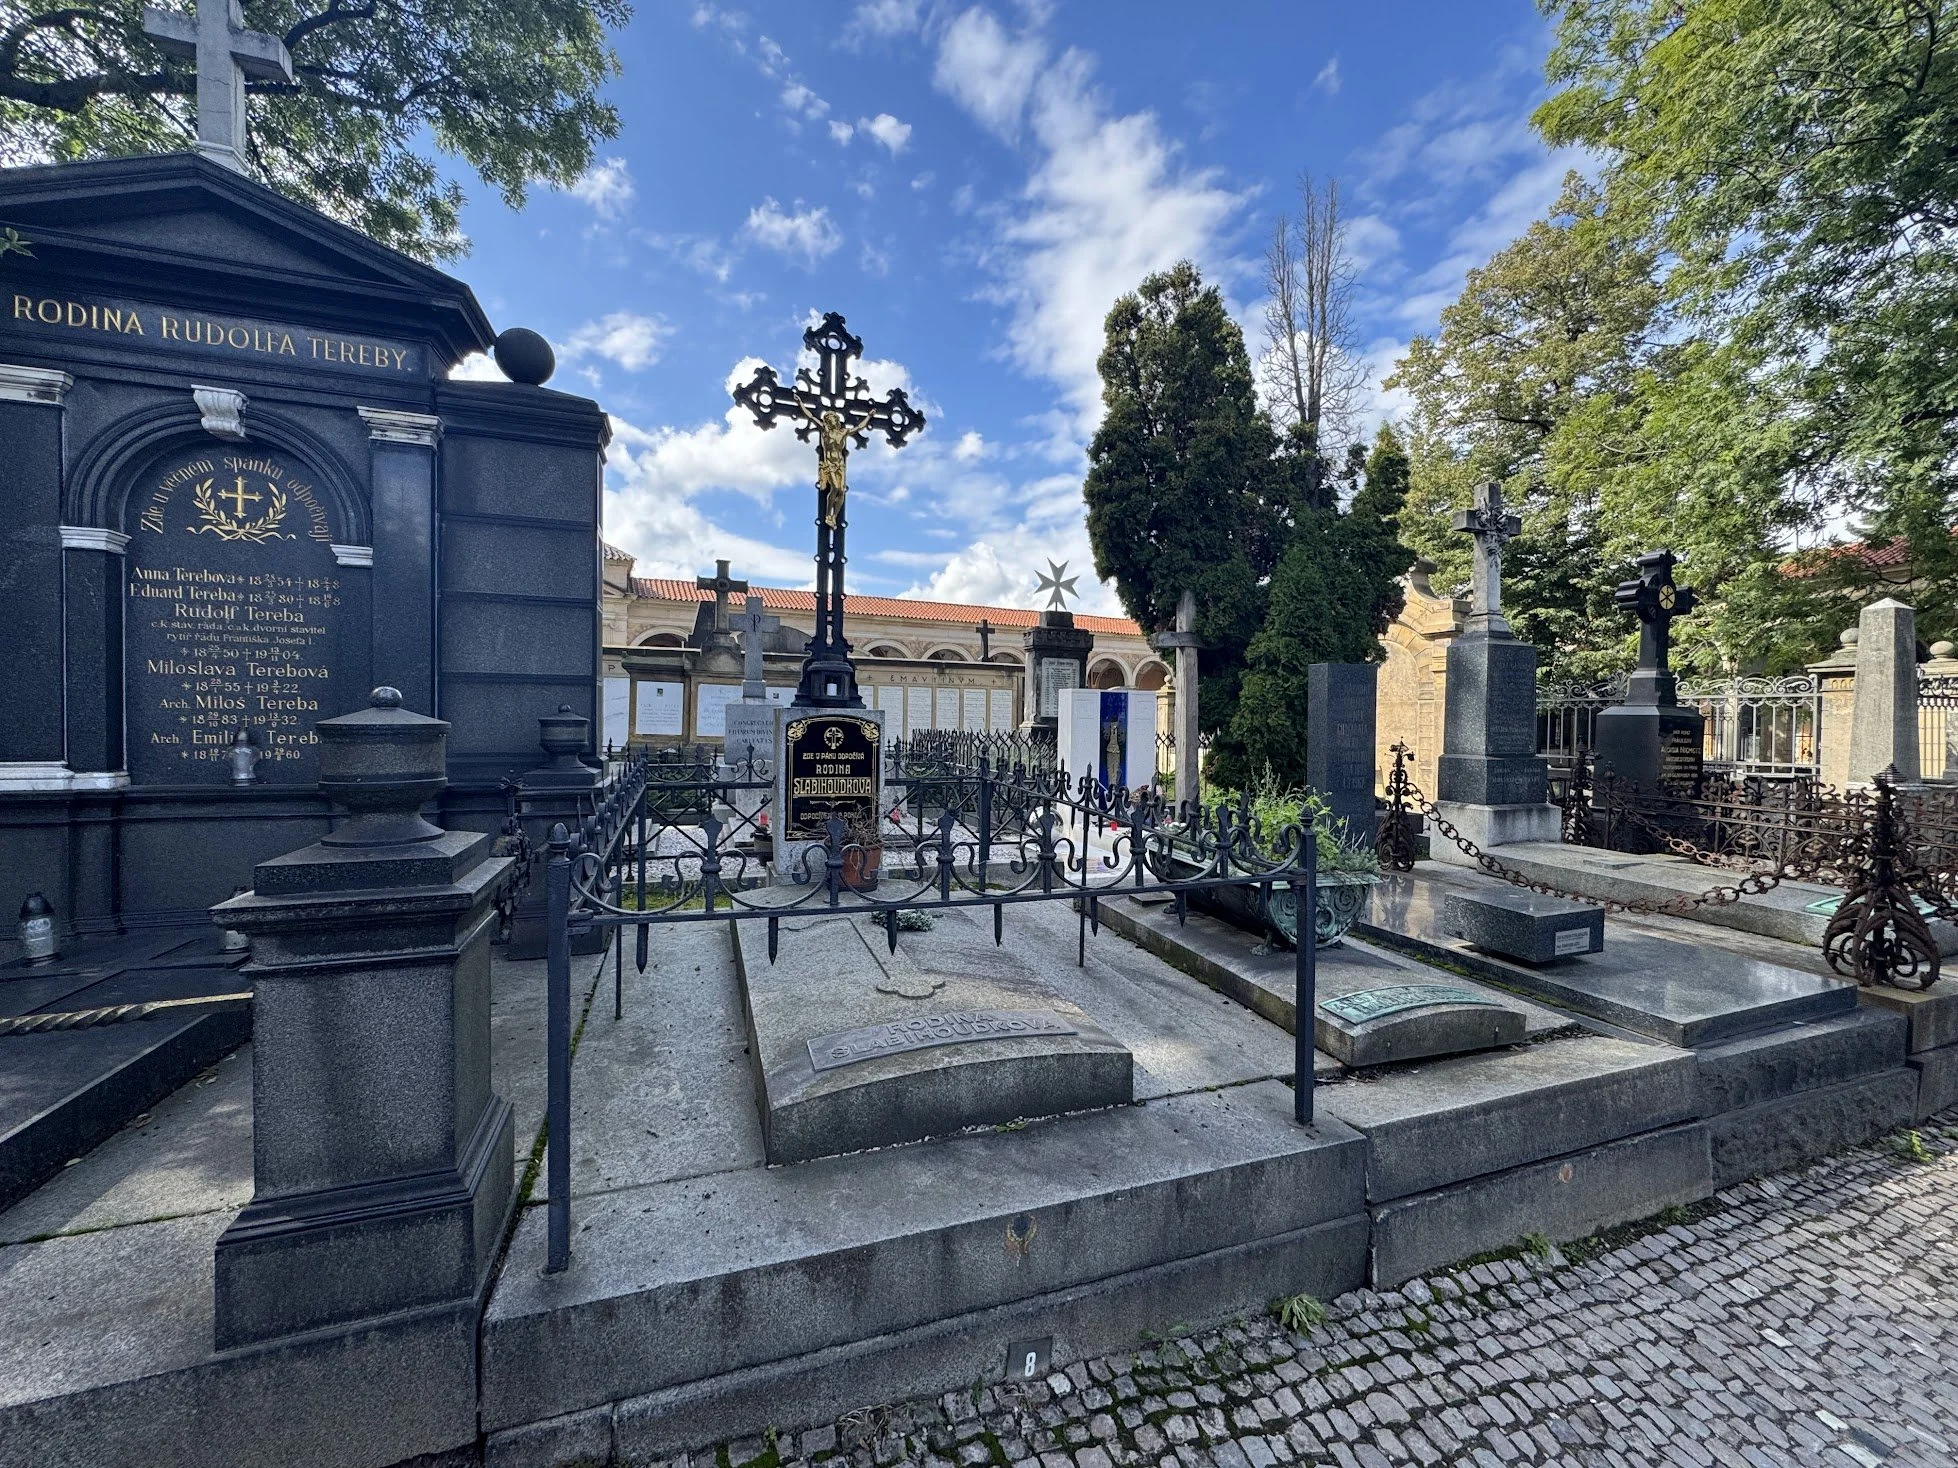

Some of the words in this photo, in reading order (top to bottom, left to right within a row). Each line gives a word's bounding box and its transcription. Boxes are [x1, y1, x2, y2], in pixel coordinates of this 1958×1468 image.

[13, 294, 145, 337] RODINA
[161, 316, 297, 357] RUDOLFA
[140, 505, 165, 535] Zde
[131, 566, 170, 584] Anna
[129, 582, 182, 601] Eduard
[187, 585, 236, 604] Tereba
[174, 603, 240, 621] Rudolf
[244, 605, 304, 623] Tereba
[272, 635, 305, 645] Josefa
[290, 626, 326, 635] stavitel
[147, 659, 236, 677] Miloslava
[246, 662, 329, 679] Terebová
[195, 694, 246, 710] Miloš
[256, 696, 319, 711] Tereba
[192, 730, 234, 745] Emili
[815, 764, 851, 775] RODINA
[886, 1012, 995, 1035] RODINA
[830, 1018, 1062, 1059] SLABIHOUDKOVA
[1024, 1351, 1037, 1377] 8
